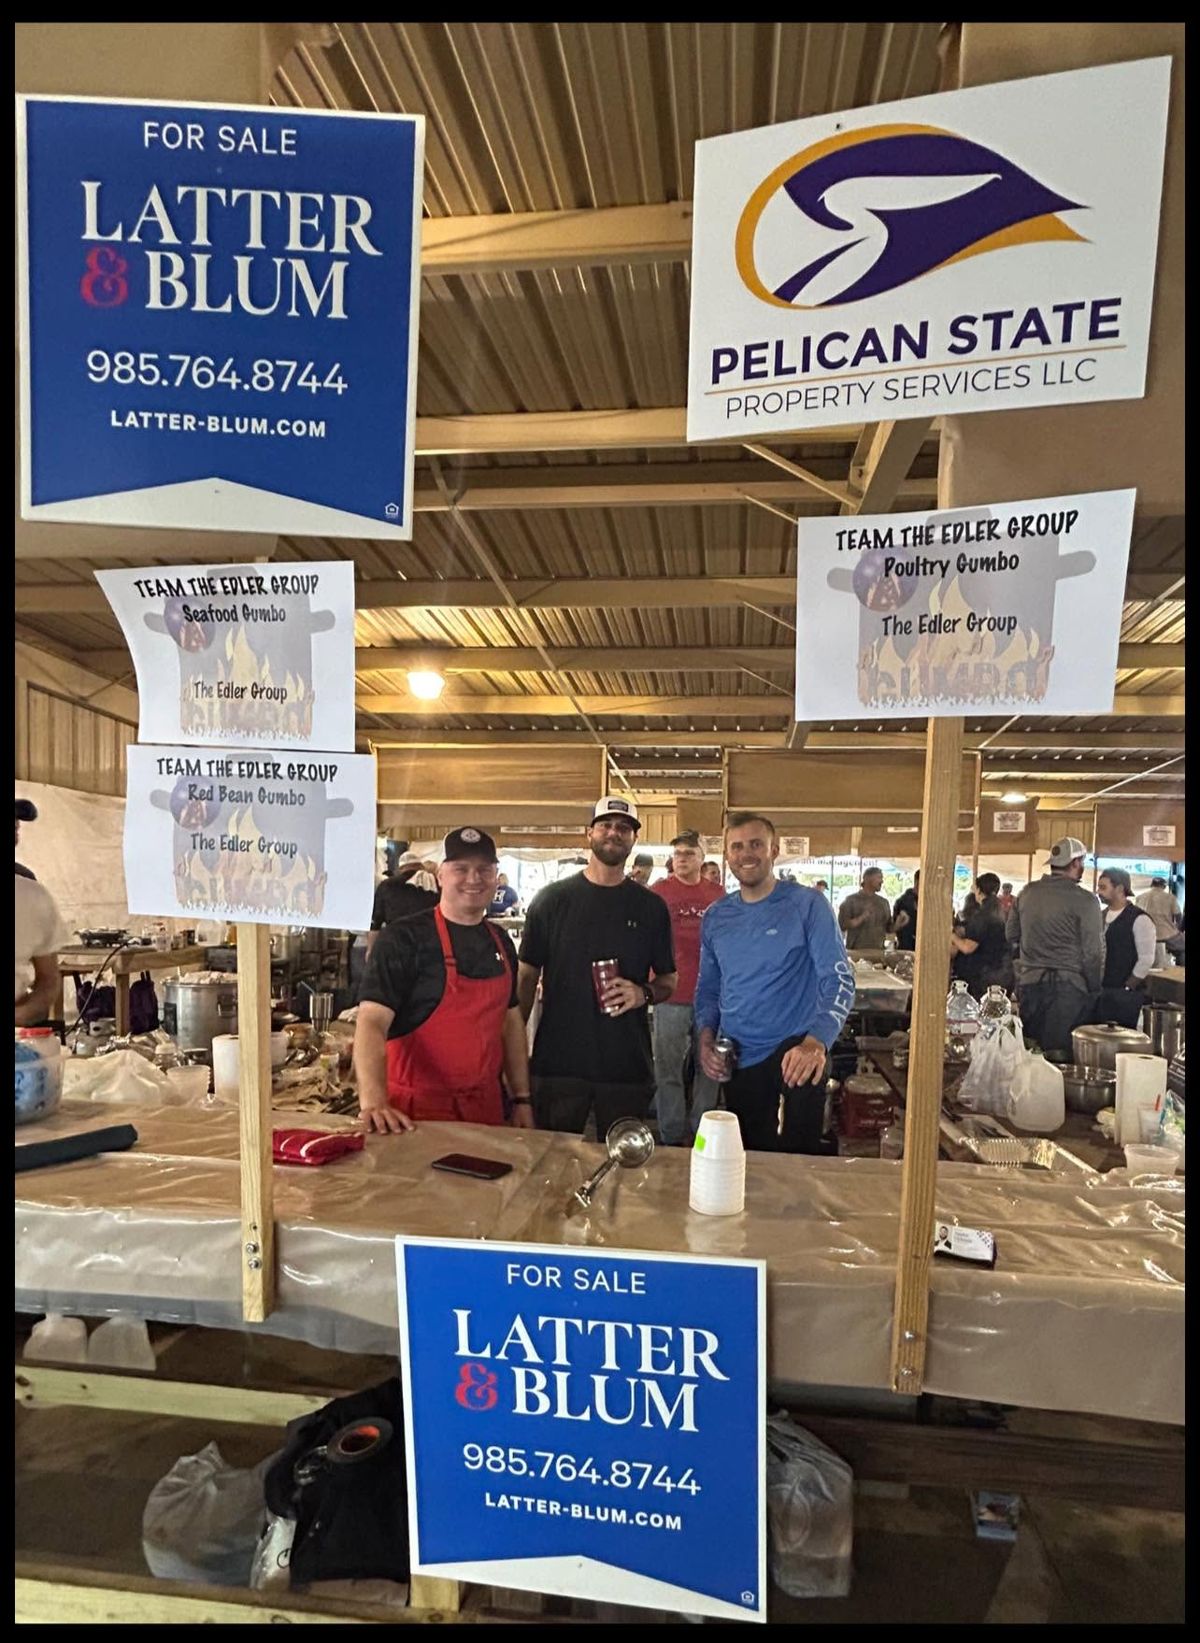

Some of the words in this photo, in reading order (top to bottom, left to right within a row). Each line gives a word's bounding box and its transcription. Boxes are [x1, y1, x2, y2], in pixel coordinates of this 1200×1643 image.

[144, 121, 205, 151] FOR
[217, 125, 297, 155] SALE
[80, 180, 383, 256] LATTER
[80, 246, 128, 308] &
[145, 250, 350, 319] BLUM
[711, 319, 930, 385] PELICAN
[947, 297, 1122, 354] STATE
[86, 350, 348, 394] 985.764.8744
[726, 380, 875, 420] PROPERTY
[883, 364, 1031, 402] SERVICES
[1043, 357, 1097, 386] LLC
[110, 409, 326, 438] LATTER-BLUM.COM
[836, 526, 894, 551] TEAM
[900, 523, 936, 547] THE
[941, 518, 1000, 545] EDLER
[1007, 509, 1079, 537] GROUP
[884, 555, 950, 578] Poultry
[956, 551, 1020, 574] Gumbo
[134, 579, 185, 598] TEAM
[187, 576, 217, 595] THE
[221, 576, 268, 595] EDLER
[270, 574, 319, 594] GROUP
[183, 605, 239, 623] Seafood
[242, 605, 286, 623] Gumbo
[882, 616, 913, 636] The
[918, 613, 961, 634] Edler
[966, 612, 1018, 634] Group
[194, 682, 214, 699] The
[217, 682, 248, 699] Edler
[251, 683, 288, 704] Group
[157, 757, 204, 777] TEAM
[206, 760, 234, 778] THE
[237, 761, 284, 780] EDLER
[287, 762, 338, 783] GROUP
[188, 785, 215, 803] Red
[218, 786, 253, 803] Bean
[257, 788, 306, 806] Gumbo
[190, 833, 216, 850] The
[220, 834, 253, 853] Edler
[258, 837, 298, 857] Group
[507, 1264, 562, 1288] FOR
[574, 1268, 647, 1294] SALE
[452, 1308, 730, 1381] LATTER
[454, 1361, 499, 1412] &
[511, 1366, 699, 1433] BLUM
[462, 1443, 702, 1496] 985.764.8744
[484, 1492, 682, 1531] LATTER-BLUM.COM
